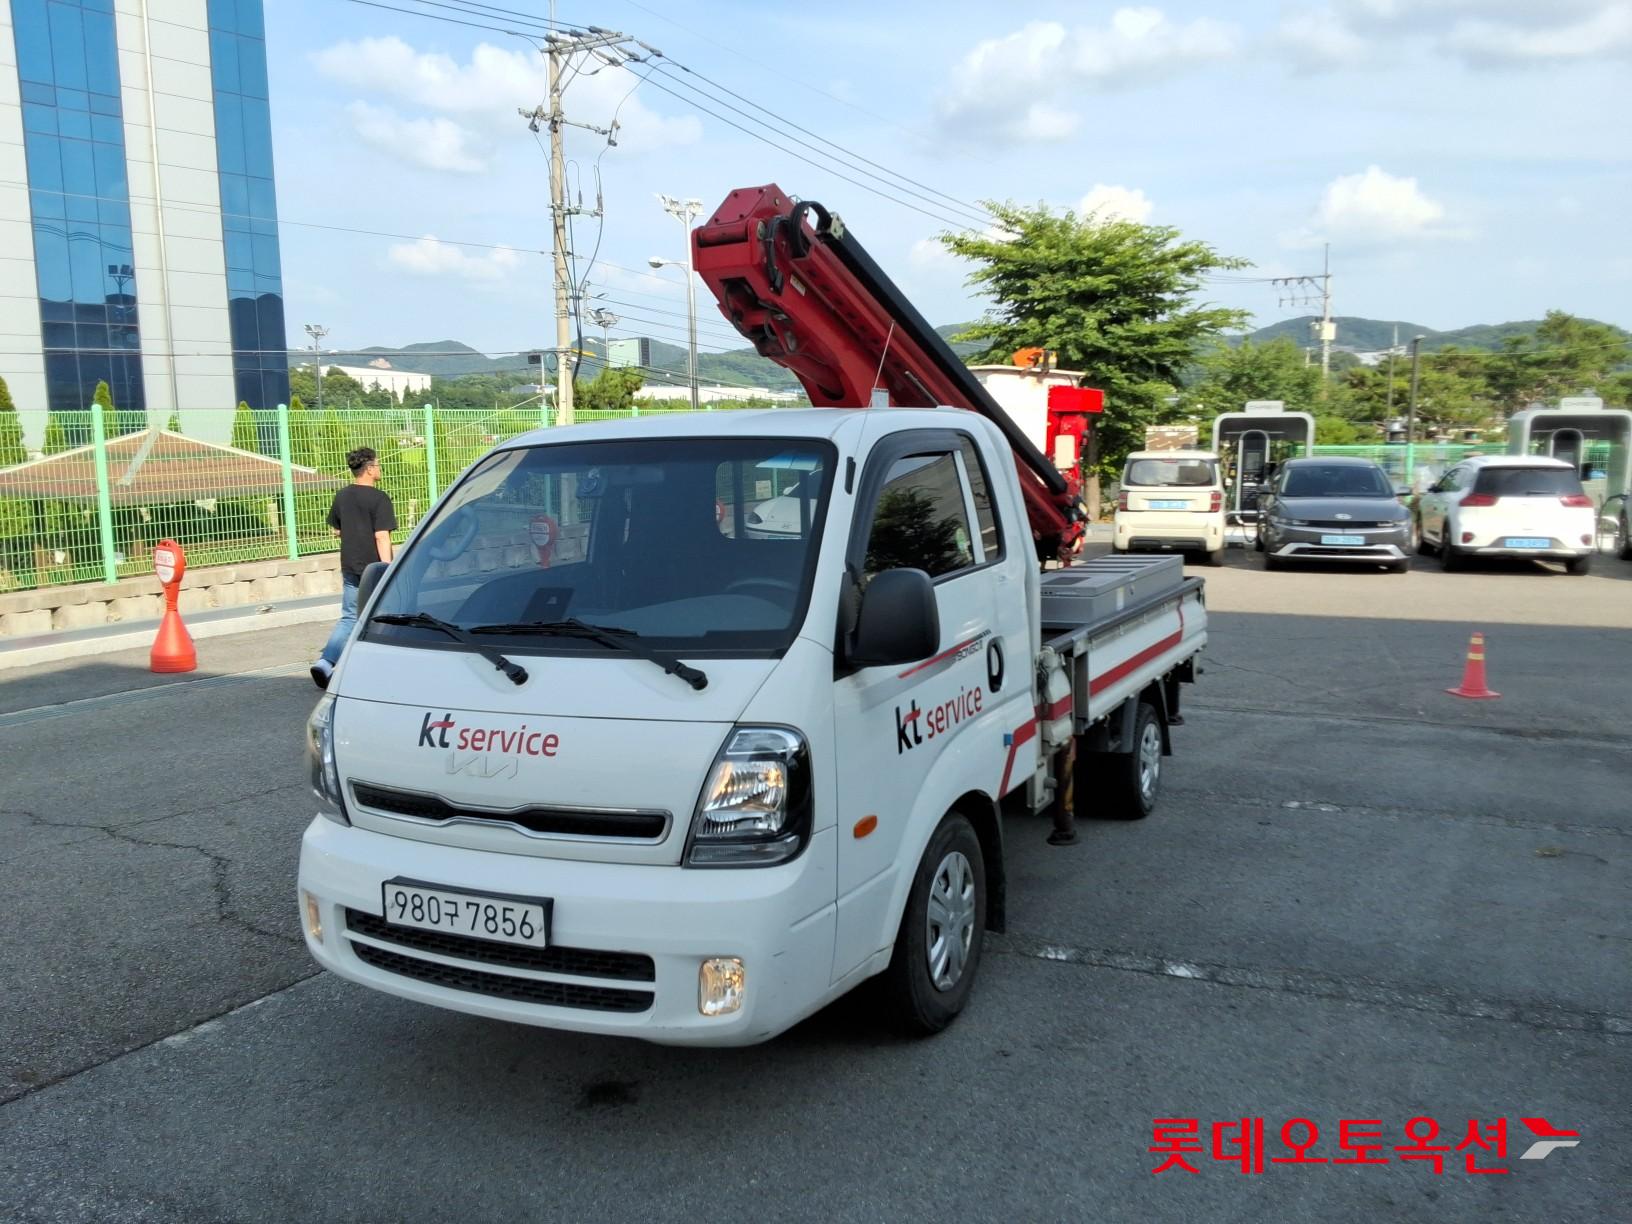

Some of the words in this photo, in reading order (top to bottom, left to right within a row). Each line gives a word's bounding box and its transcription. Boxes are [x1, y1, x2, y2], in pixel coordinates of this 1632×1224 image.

[418, 712, 455, 749] kt
[457, 724, 559, 757] service
[895, 699, 922, 755] kt
[926, 686, 982, 739] service
